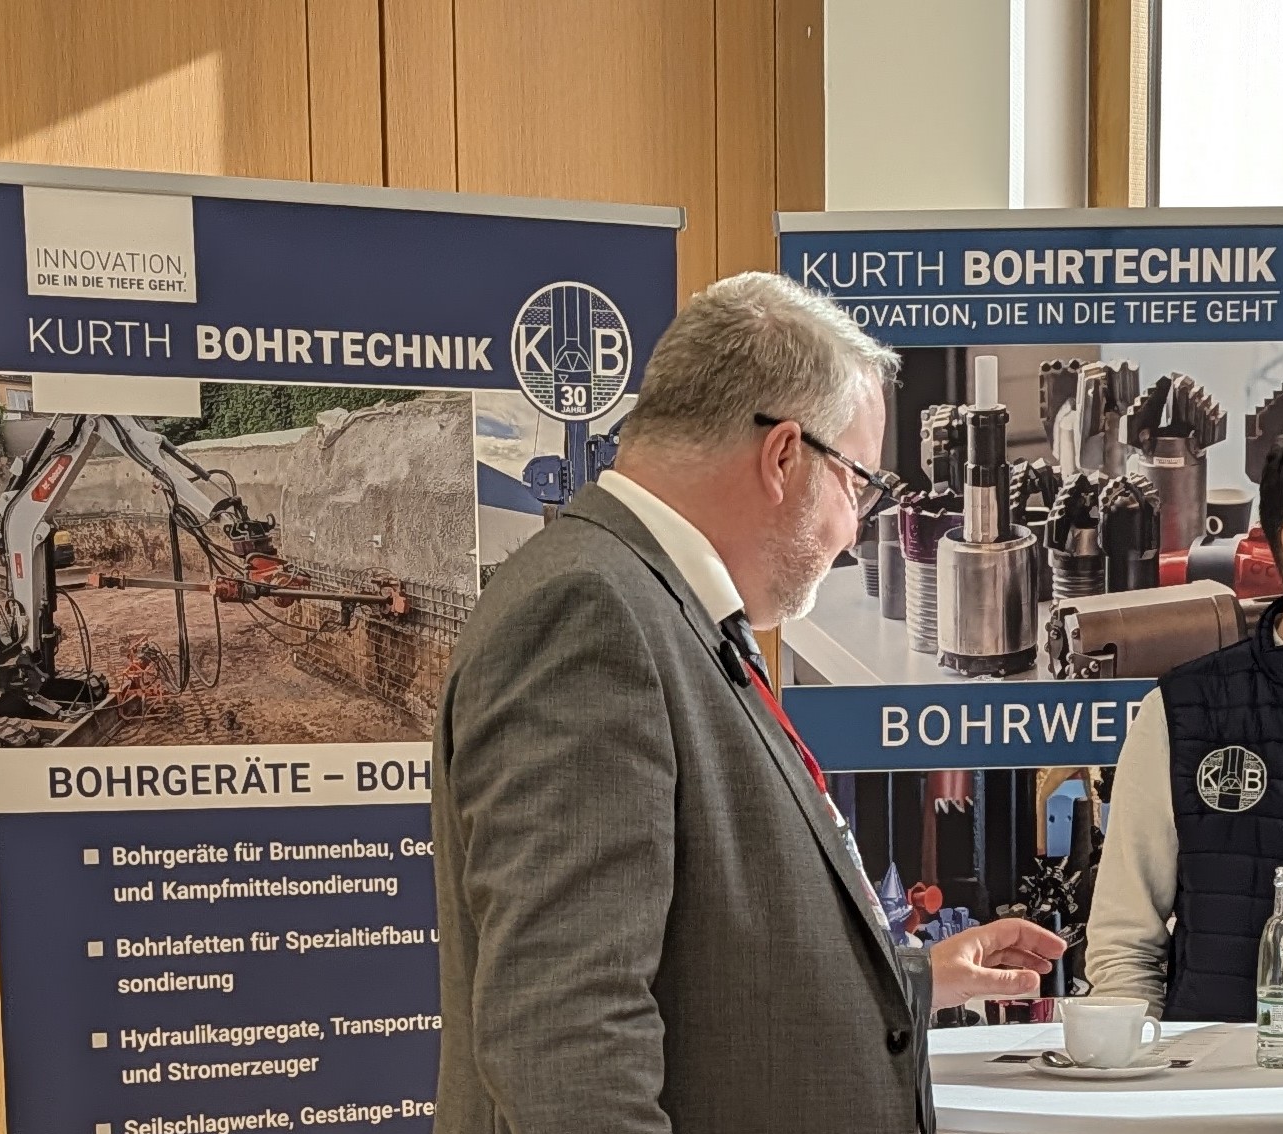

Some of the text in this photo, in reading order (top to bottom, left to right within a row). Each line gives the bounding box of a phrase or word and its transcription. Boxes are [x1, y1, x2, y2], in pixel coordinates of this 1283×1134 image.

[36, 248, 187, 279] INNOVATION,
[803, 246, 1278, 288] KURTH BOHRTECHNIK
[37, 273, 187, 293] DIE IN DIE TIEFE GEHT.
[838, 299, 1278, 330] OVATION, DIE IN DIE TIEFE GEHT
[28, 317, 493, 372] KURTH BOHRTECHNIK
[560, 385, 587, 407] 30
[561, 406, 587, 414] JAHRE
[48, 756, 311, 799] BOHRGERÄTE
[112, 843, 229, 869] Bohrgeräte
[233, 841, 264, 862] für
[269, 838, 394, 861] Brunnenbau,
[113, 874, 398, 904] und Kampfmittelsondierung
[116, 934, 245, 958] Bohrlafetten
[249, 931, 280, 952] für
[285, 925, 425, 954] Spezialtiefbau
[117, 971, 234, 994] sondierung
[120, 1020, 325, 1053] Hydraulikaggregate,
[121, 1057, 320, 1085] und Stromerzeuger
